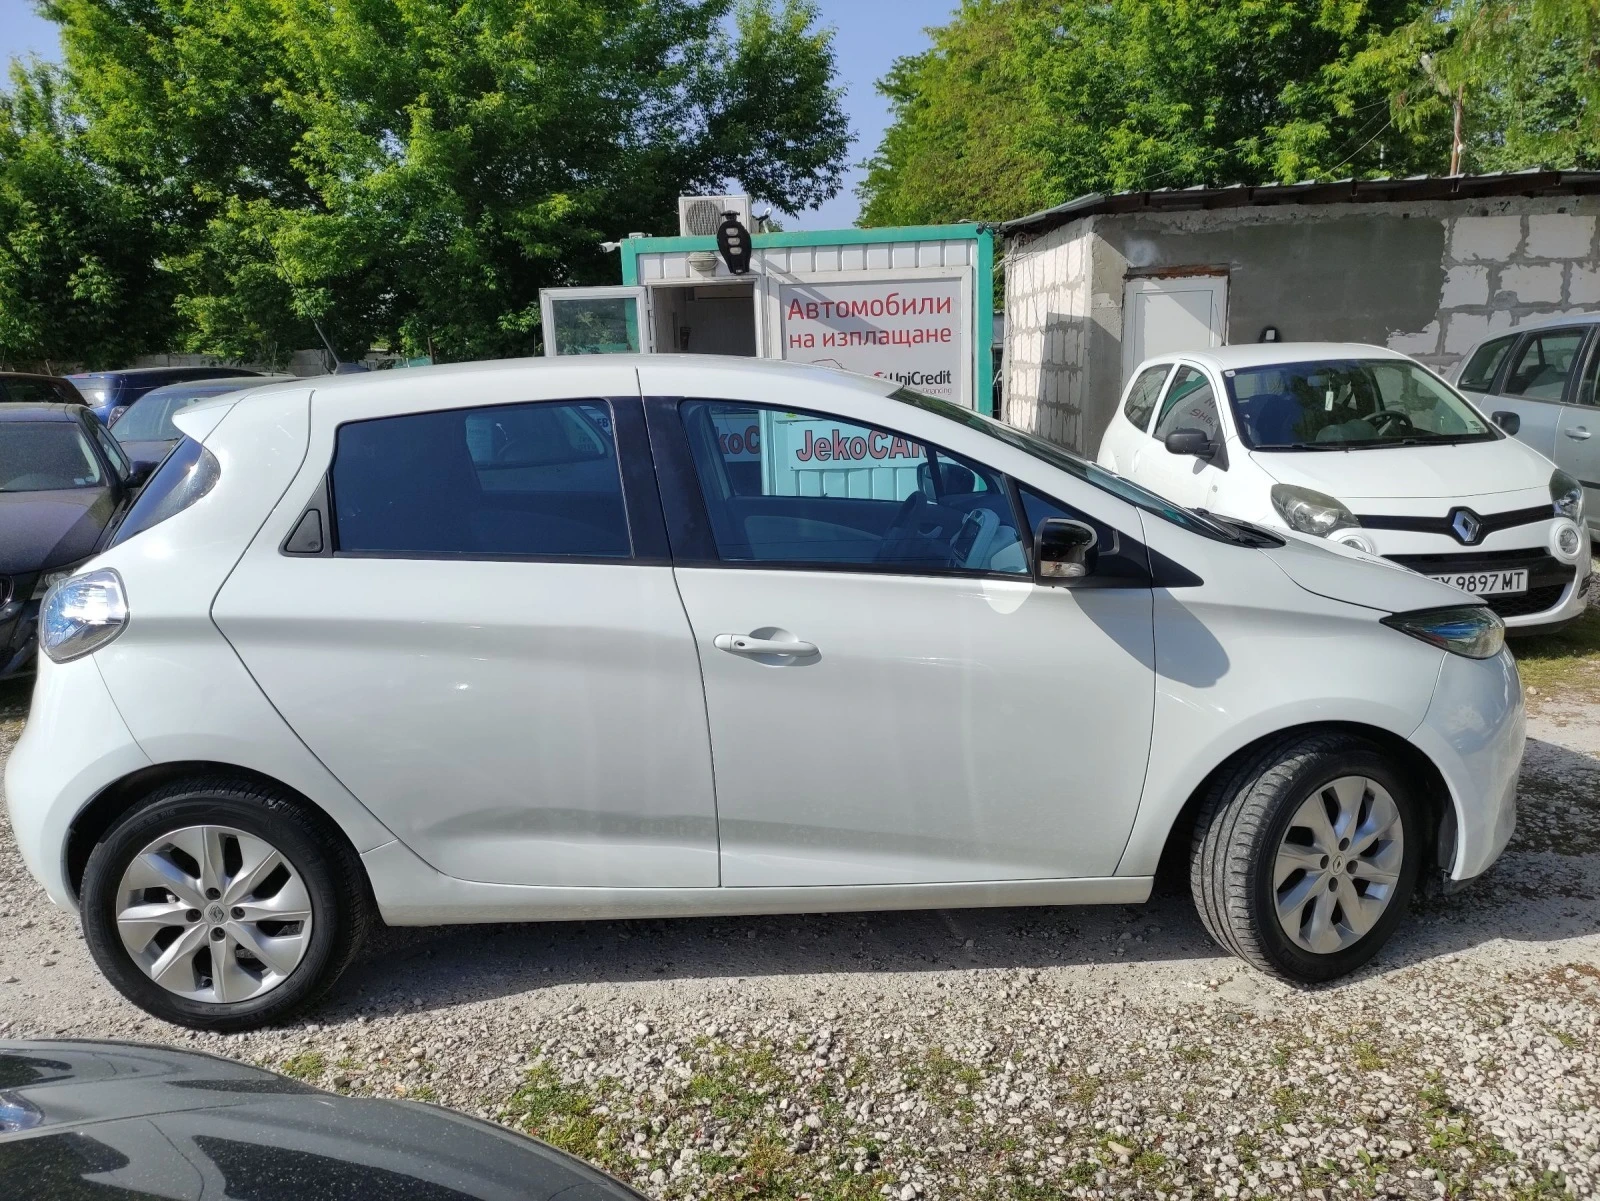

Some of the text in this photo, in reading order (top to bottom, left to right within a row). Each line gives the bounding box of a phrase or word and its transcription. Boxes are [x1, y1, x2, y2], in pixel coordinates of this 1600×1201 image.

[787, 292, 951, 321] Автомобили
[789, 326, 952, 349] на изплащане
[796, 428, 947, 462] JekoCA
[1455, 574, 1499, 593] 9897
[1501, 571, 1524, 591] MT
